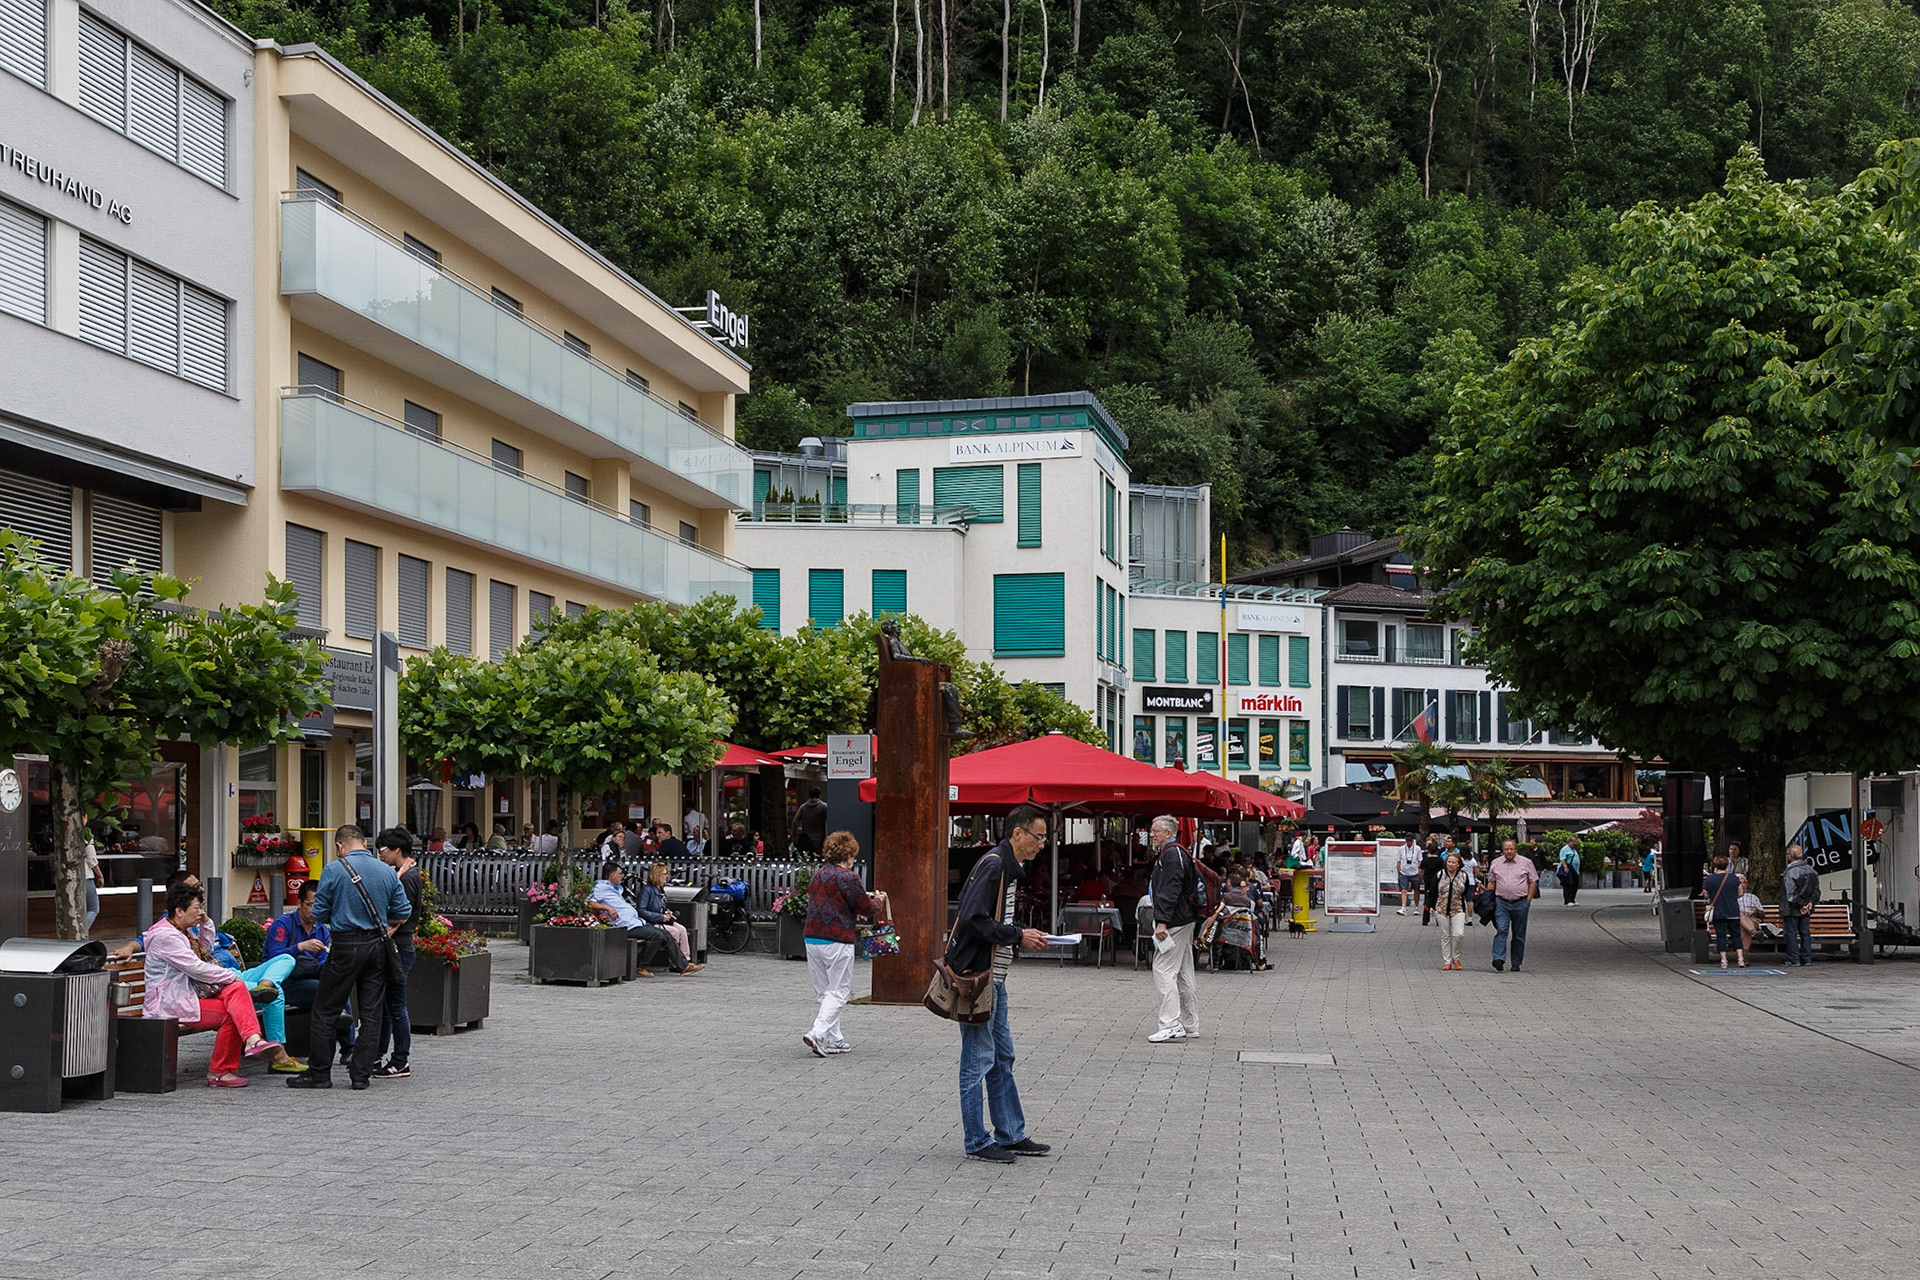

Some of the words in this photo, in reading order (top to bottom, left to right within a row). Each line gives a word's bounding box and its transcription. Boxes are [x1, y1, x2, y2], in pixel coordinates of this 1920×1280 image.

[0, 142, 104, 209] TREUHAND
[108, 199, 133, 224] AG
[708, 290, 748, 348] Engel
[956, 443, 991, 455] BANK
[995, 440, 1057, 453] ALPINUM
[1242, 613, 1261, 621] BANK
[1262, 614, 1293, 623] ALPINUM
[1147, 696, 1203, 709] MONTBLANC
[1241, 694, 1302, 712] märklin
[835, 756, 863, 767] Engel
[1805, 848, 1840, 868] ode
[274, 927, 286, 942] 3
